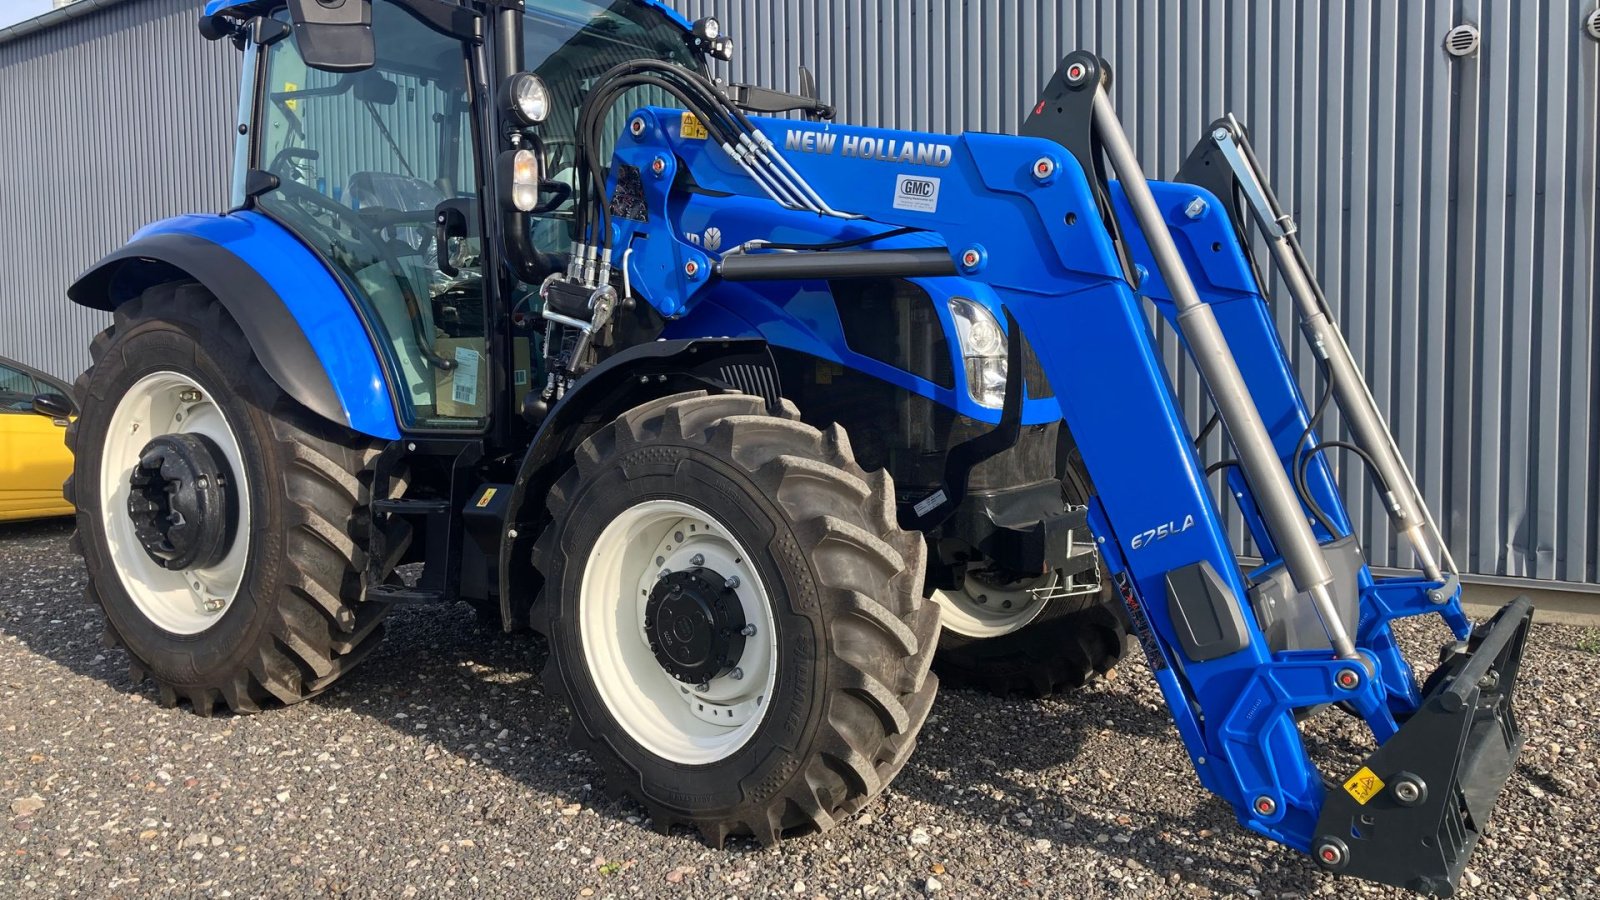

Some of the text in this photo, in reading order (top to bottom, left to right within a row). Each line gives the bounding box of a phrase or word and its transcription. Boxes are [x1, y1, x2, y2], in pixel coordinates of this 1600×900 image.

[785, 129, 953, 168] NEW HOLLAND
[905, 181, 930, 196] GMC
[1131, 514, 1194, 550] 675LA
